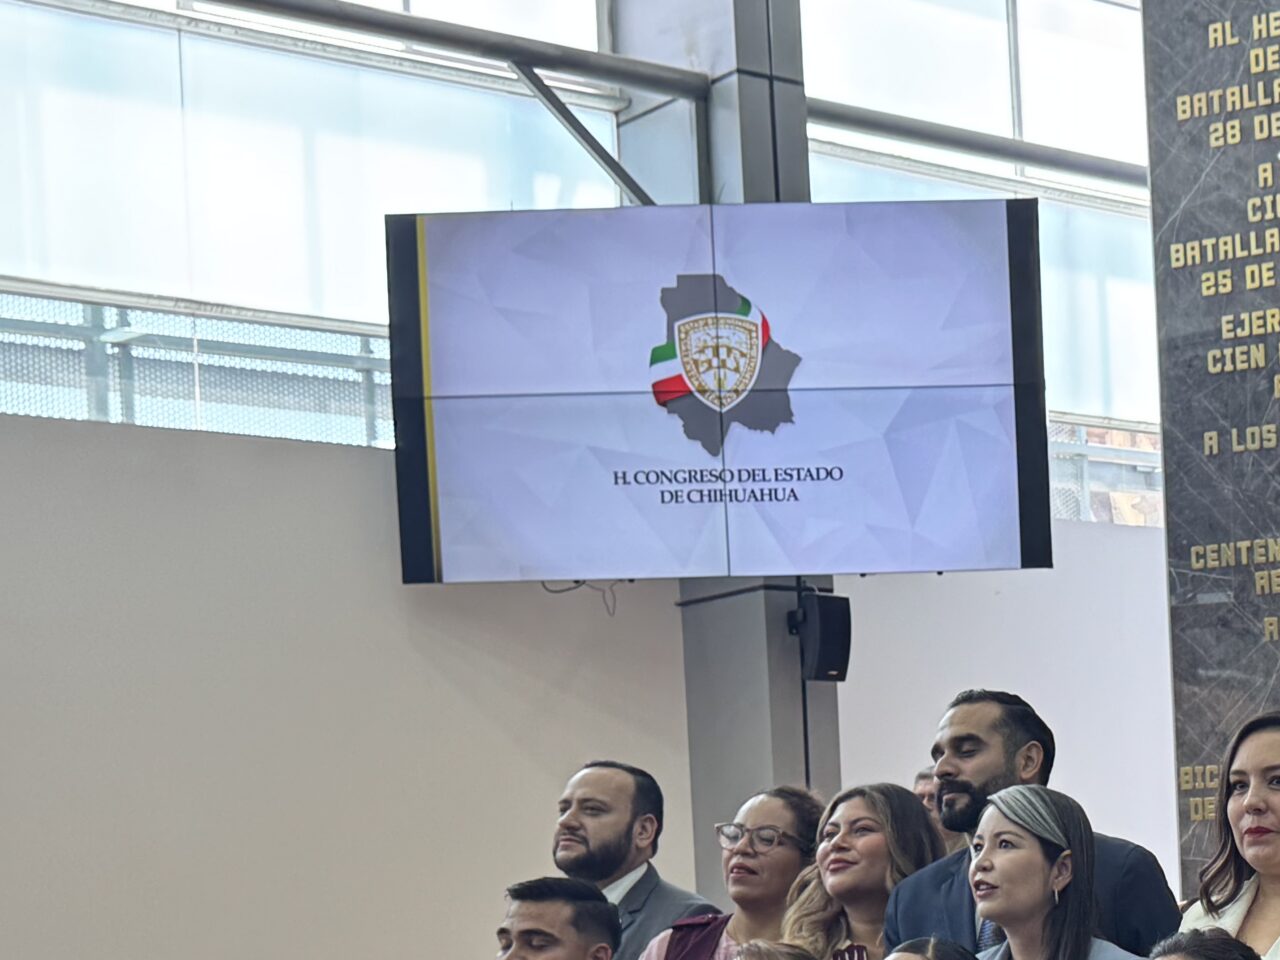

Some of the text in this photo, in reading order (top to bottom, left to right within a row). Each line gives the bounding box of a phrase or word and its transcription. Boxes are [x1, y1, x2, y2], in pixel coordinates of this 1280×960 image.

[1208, 22, 1239, 48] AL
[1250, 46, 1280, 74] DE
[1209, 118, 1241, 148] 28
[1258, 162, 1273, 188] A
[1170, 228, 1280, 269] BATALLA
[1201, 269, 1232, 297] 25
[1246, 262, 1275, 290] DE
[1207, 344, 1265, 374] CIEN
[1203, 430, 1218, 455] A
[1232, 424, 1277, 452] LOS
[613, 466, 844, 485] H. CONGRESO DEL ESTADO
[660, 487, 800, 504] DE CHIHUAHUA
